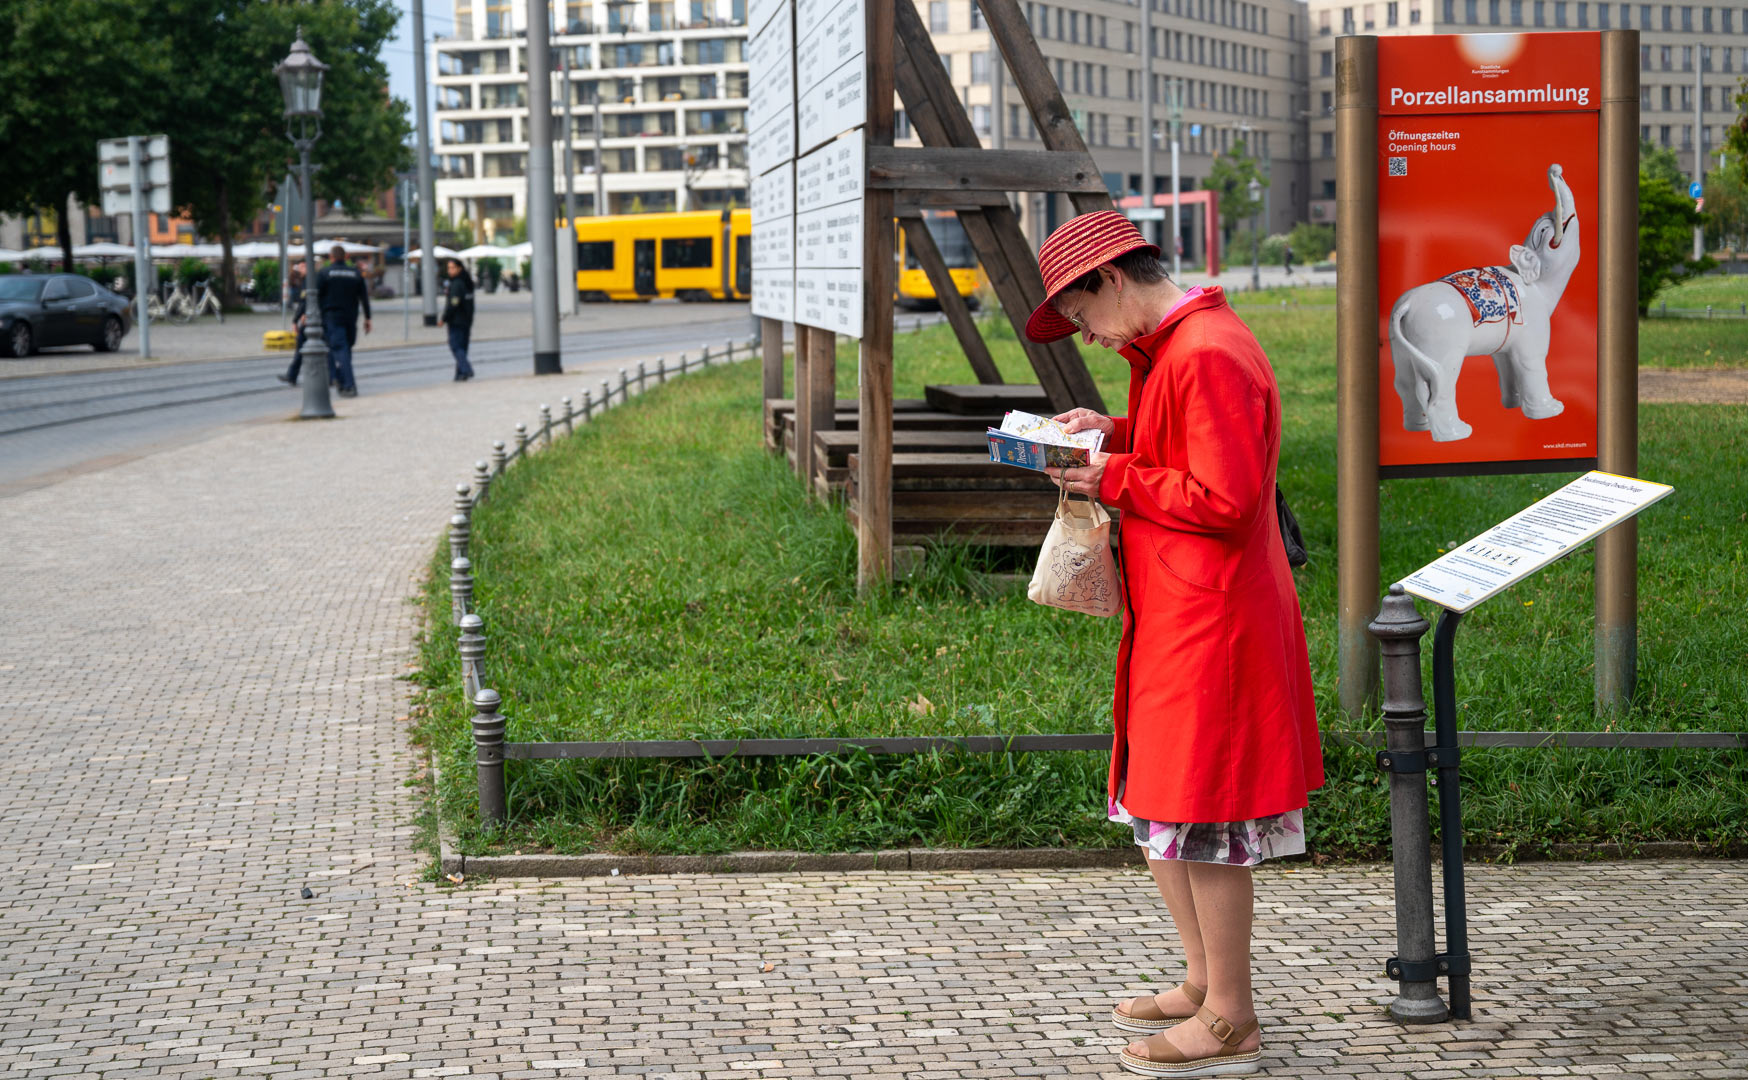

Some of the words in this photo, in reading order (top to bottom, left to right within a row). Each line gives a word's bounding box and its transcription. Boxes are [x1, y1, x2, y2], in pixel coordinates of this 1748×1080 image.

[1390, 83, 1590, 106] Porzellansammlung
[1388, 129, 1460, 142] Öffnungszeiten
[1388, 142, 1428, 153] Opening
[1430, 142, 1456, 151] hours
